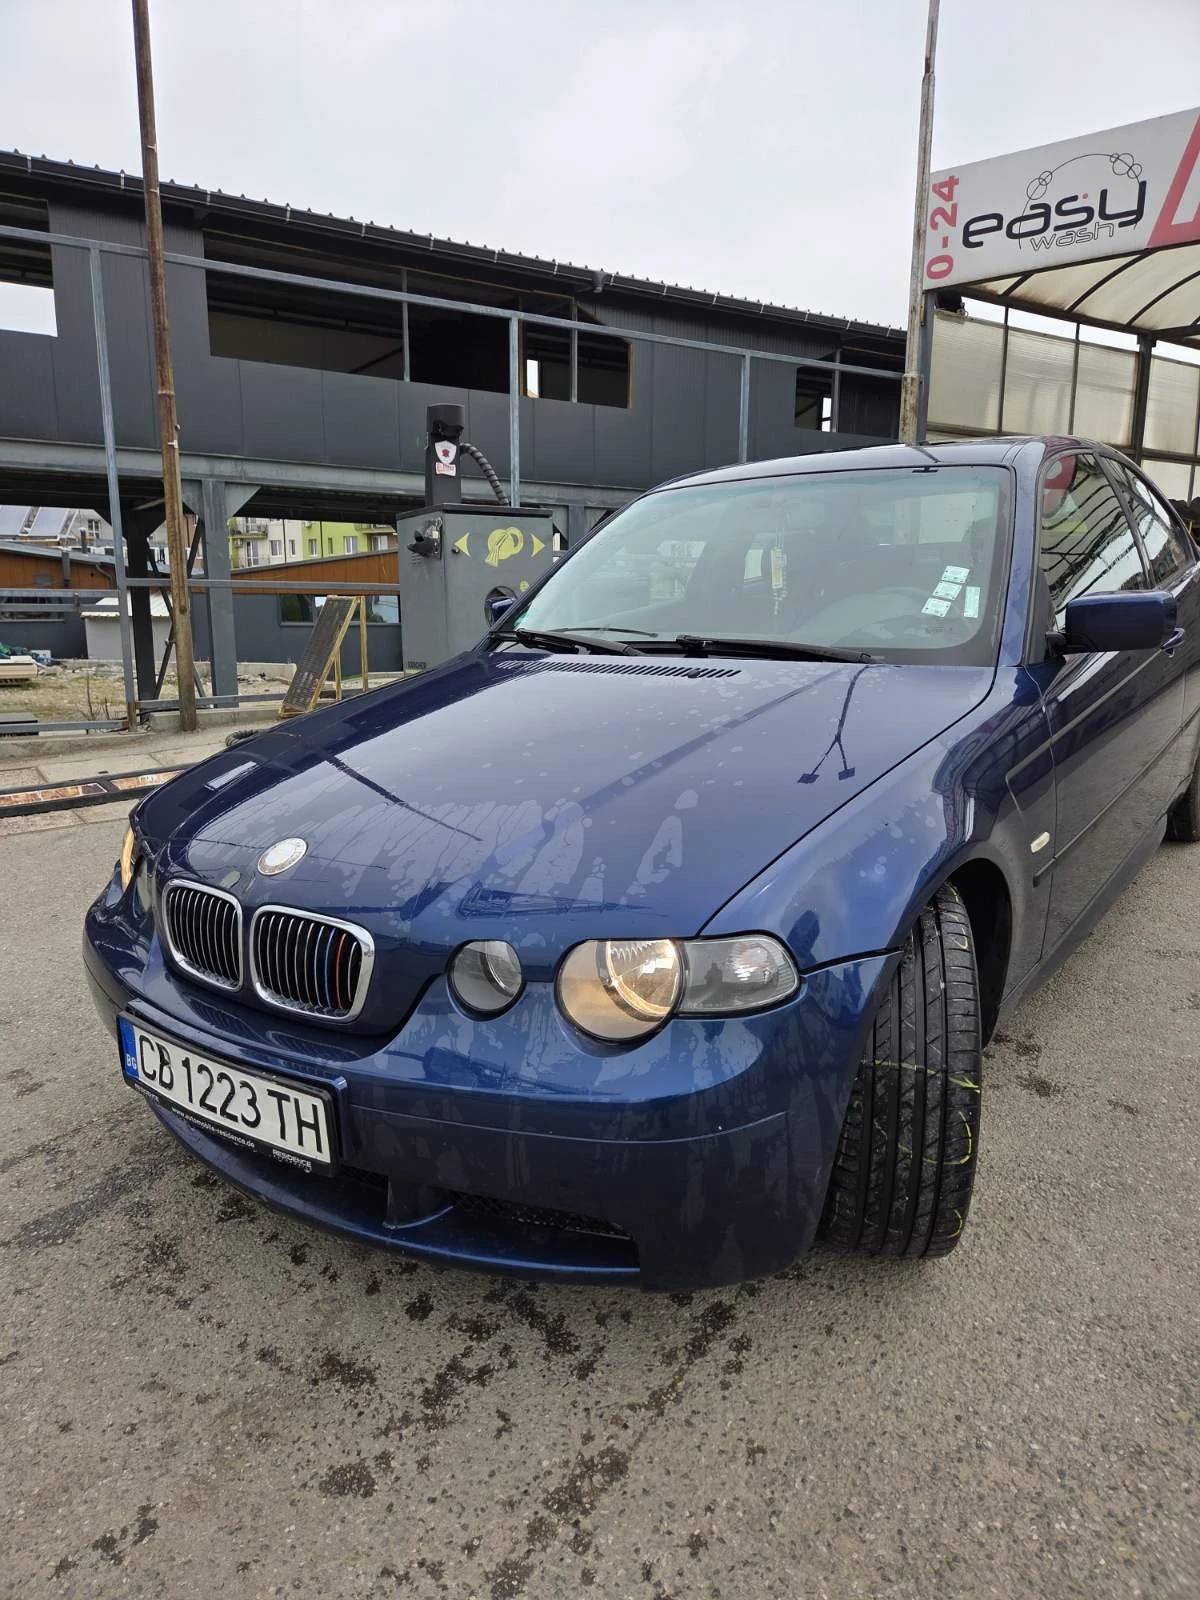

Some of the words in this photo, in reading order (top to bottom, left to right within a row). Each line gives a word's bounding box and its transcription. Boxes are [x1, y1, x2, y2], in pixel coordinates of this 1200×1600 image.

[962, 180, 1147, 249] easy
[1030, 221, 1115, 251] wash
[126, 1053, 138, 1070] BG
[139, 1034, 174, 1091] CB
[181, 1057, 262, 1129] 1223
[266, 1088, 324, 1154] TH
